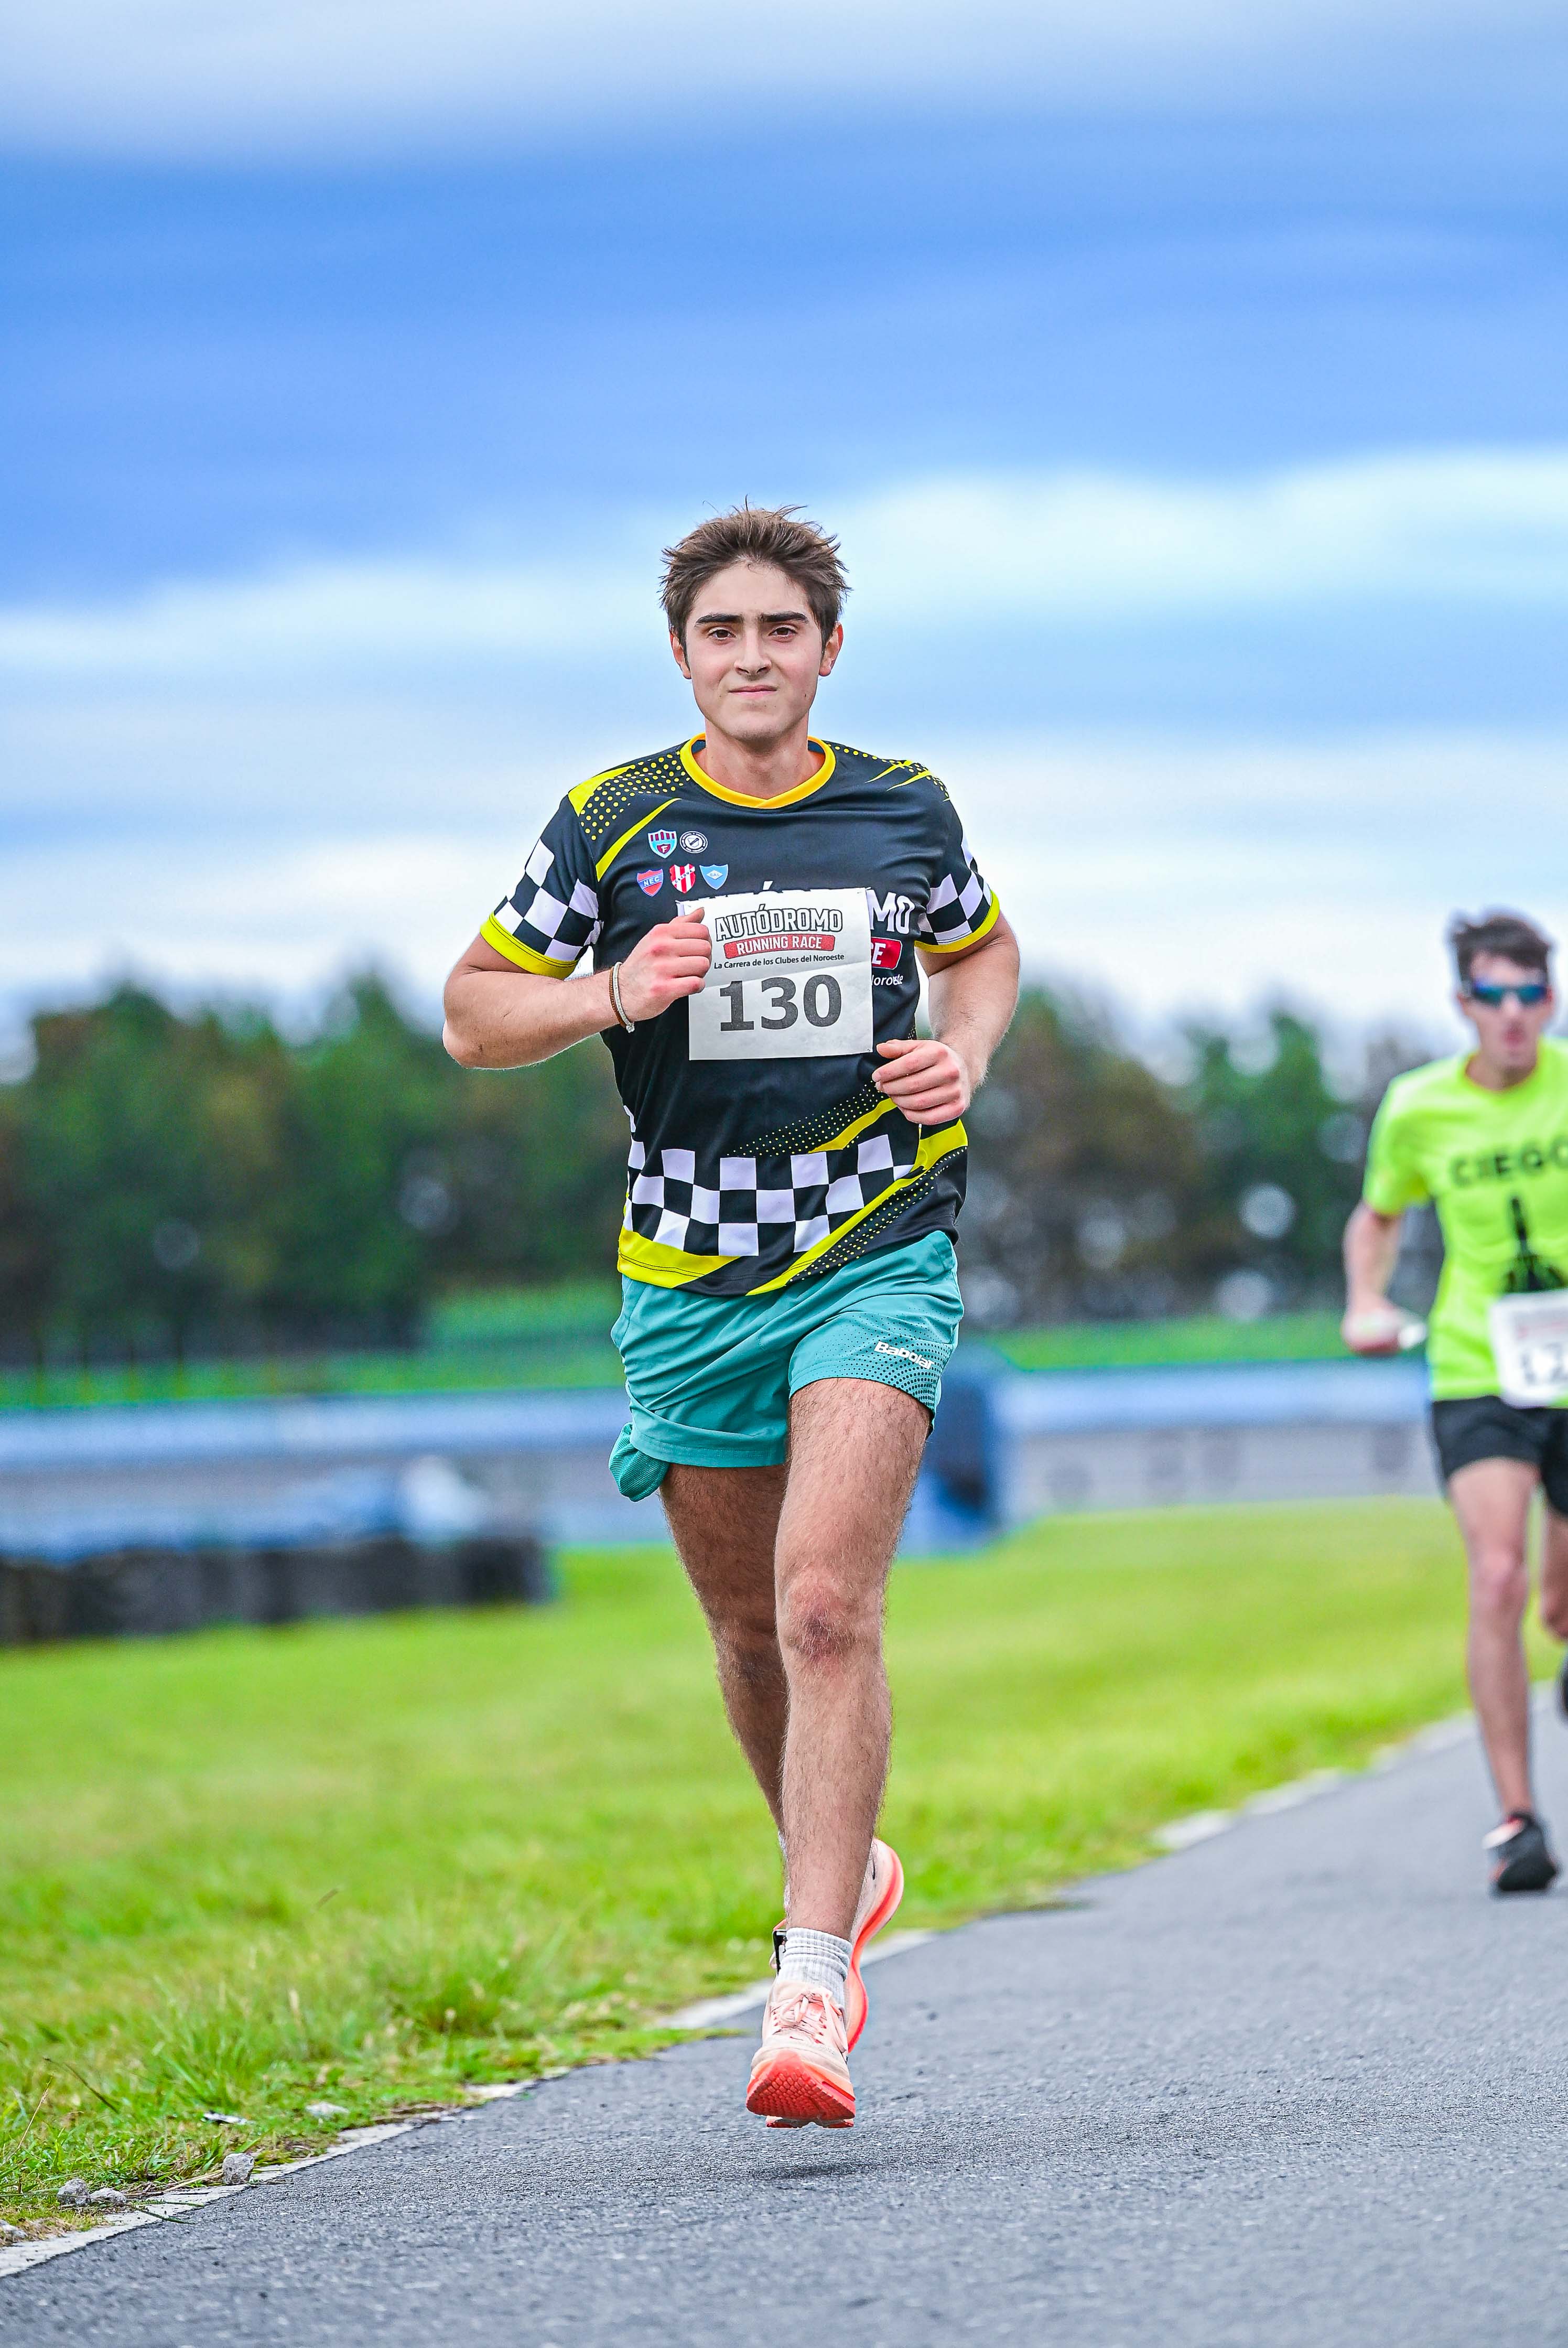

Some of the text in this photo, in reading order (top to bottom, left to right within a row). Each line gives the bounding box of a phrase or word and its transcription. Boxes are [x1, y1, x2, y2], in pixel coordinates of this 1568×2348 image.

[643, 876, 659, 887] NEC
[715, 903, 843, 942] AUTÓDROMO
[736, 935, 823, 955] RUNNING RACE
[724, 961, 751, 969] Carrera
[720, 974, 841, 1031] 130
[874, 1341, 935, 1370] Babolat
